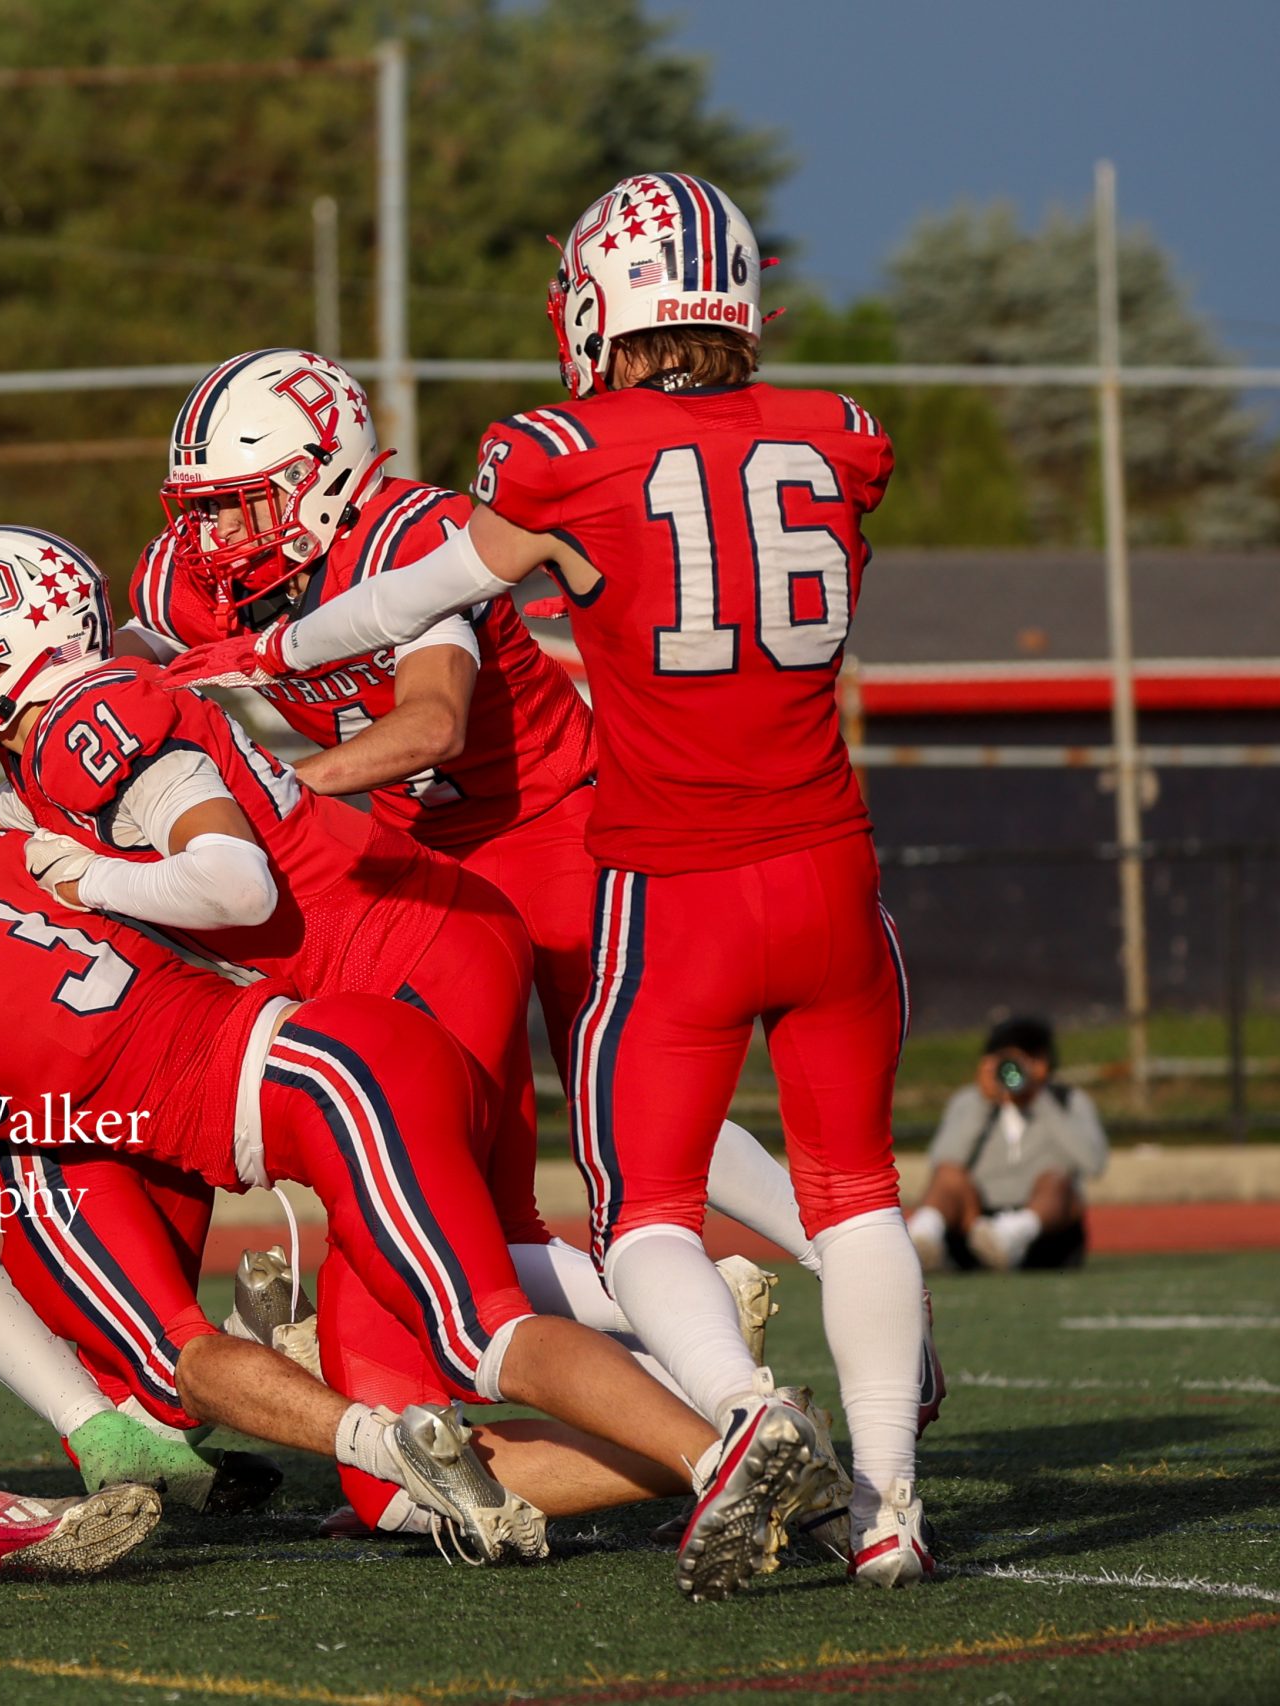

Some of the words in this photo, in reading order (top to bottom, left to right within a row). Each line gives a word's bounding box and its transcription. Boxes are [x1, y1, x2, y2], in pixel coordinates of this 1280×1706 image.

[656, 297, 749, 326] Riddell
[271, 367, 342, 455] P
[172, 470, 202, 482] Riddell
[644, 440, 850, 676] 16
[65, 702, 144, 787] 21
